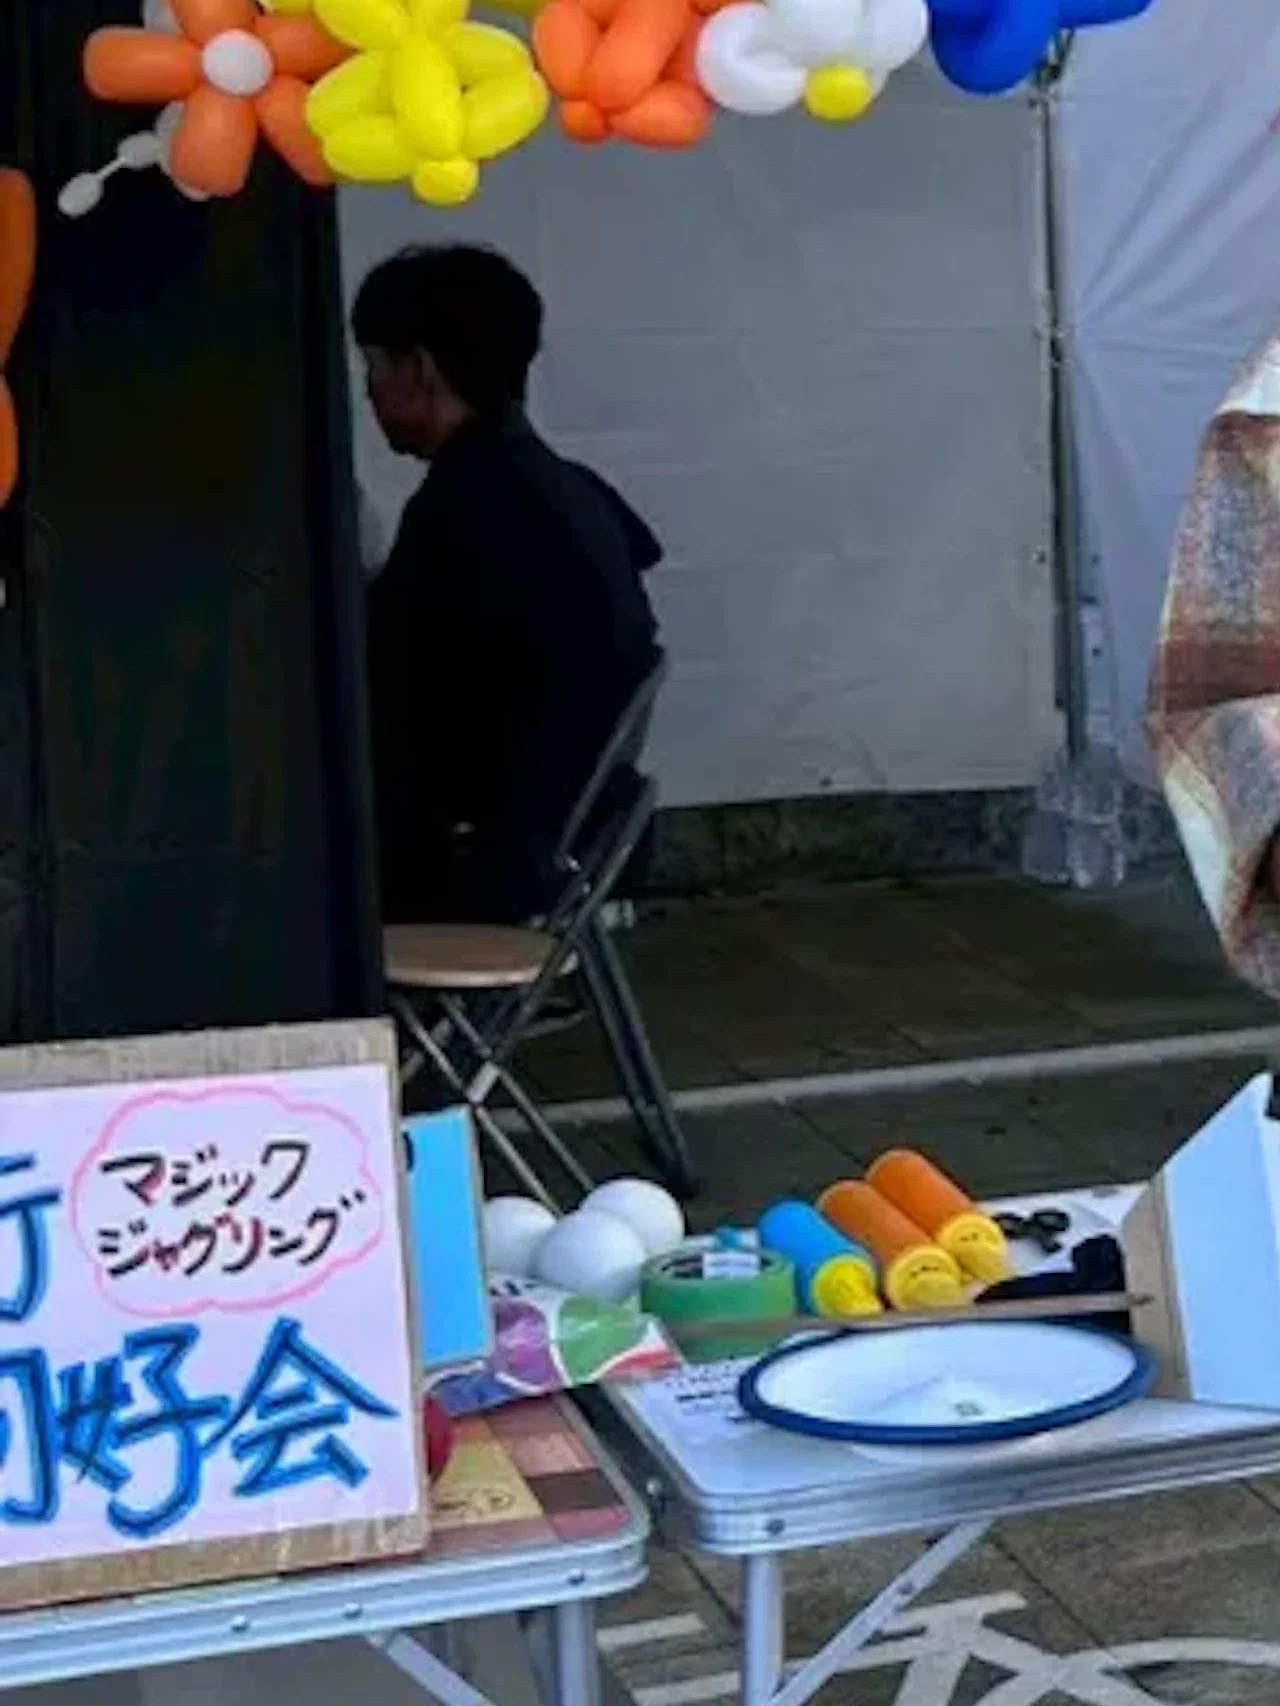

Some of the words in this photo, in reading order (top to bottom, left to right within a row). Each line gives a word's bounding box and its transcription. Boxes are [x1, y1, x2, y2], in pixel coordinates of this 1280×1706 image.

[100, 1140, 311, 1207] マジック
[97, 1188, 367, 1278] ジャグリング
